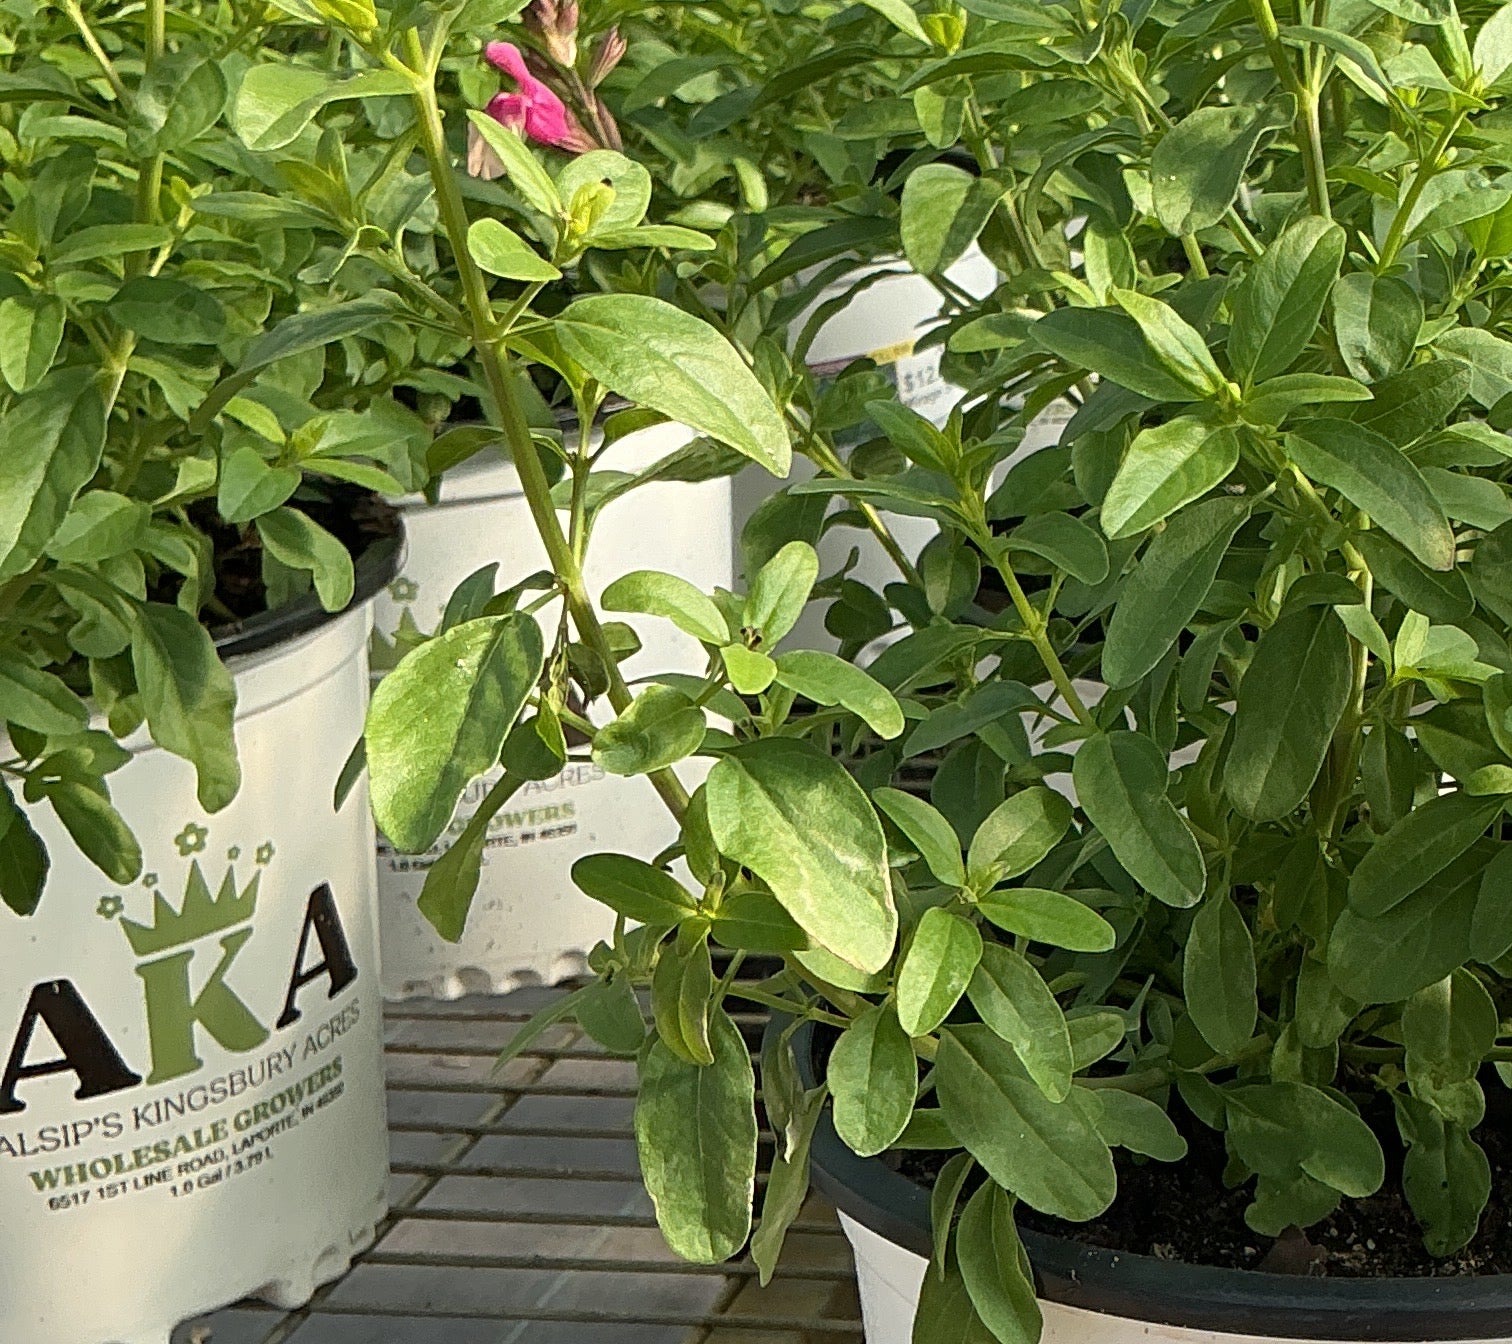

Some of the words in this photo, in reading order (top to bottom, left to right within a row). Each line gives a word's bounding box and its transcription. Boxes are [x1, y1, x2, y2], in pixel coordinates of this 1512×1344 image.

[0, 881, 359, 1114] AKA
[0, 1111, 123, 1157] ALSIP'S
[132, 1042, 297, 1131] KINGSBURY
[303, 997, 360, 1060] ACRES
[28, 1117, 229, 1192] WHOLESALE
[234, 1055, 343, 1130] GROWERS
[133, 1167, 173, 1191] LINE
[197, 1166, 223, 1188] Gal
